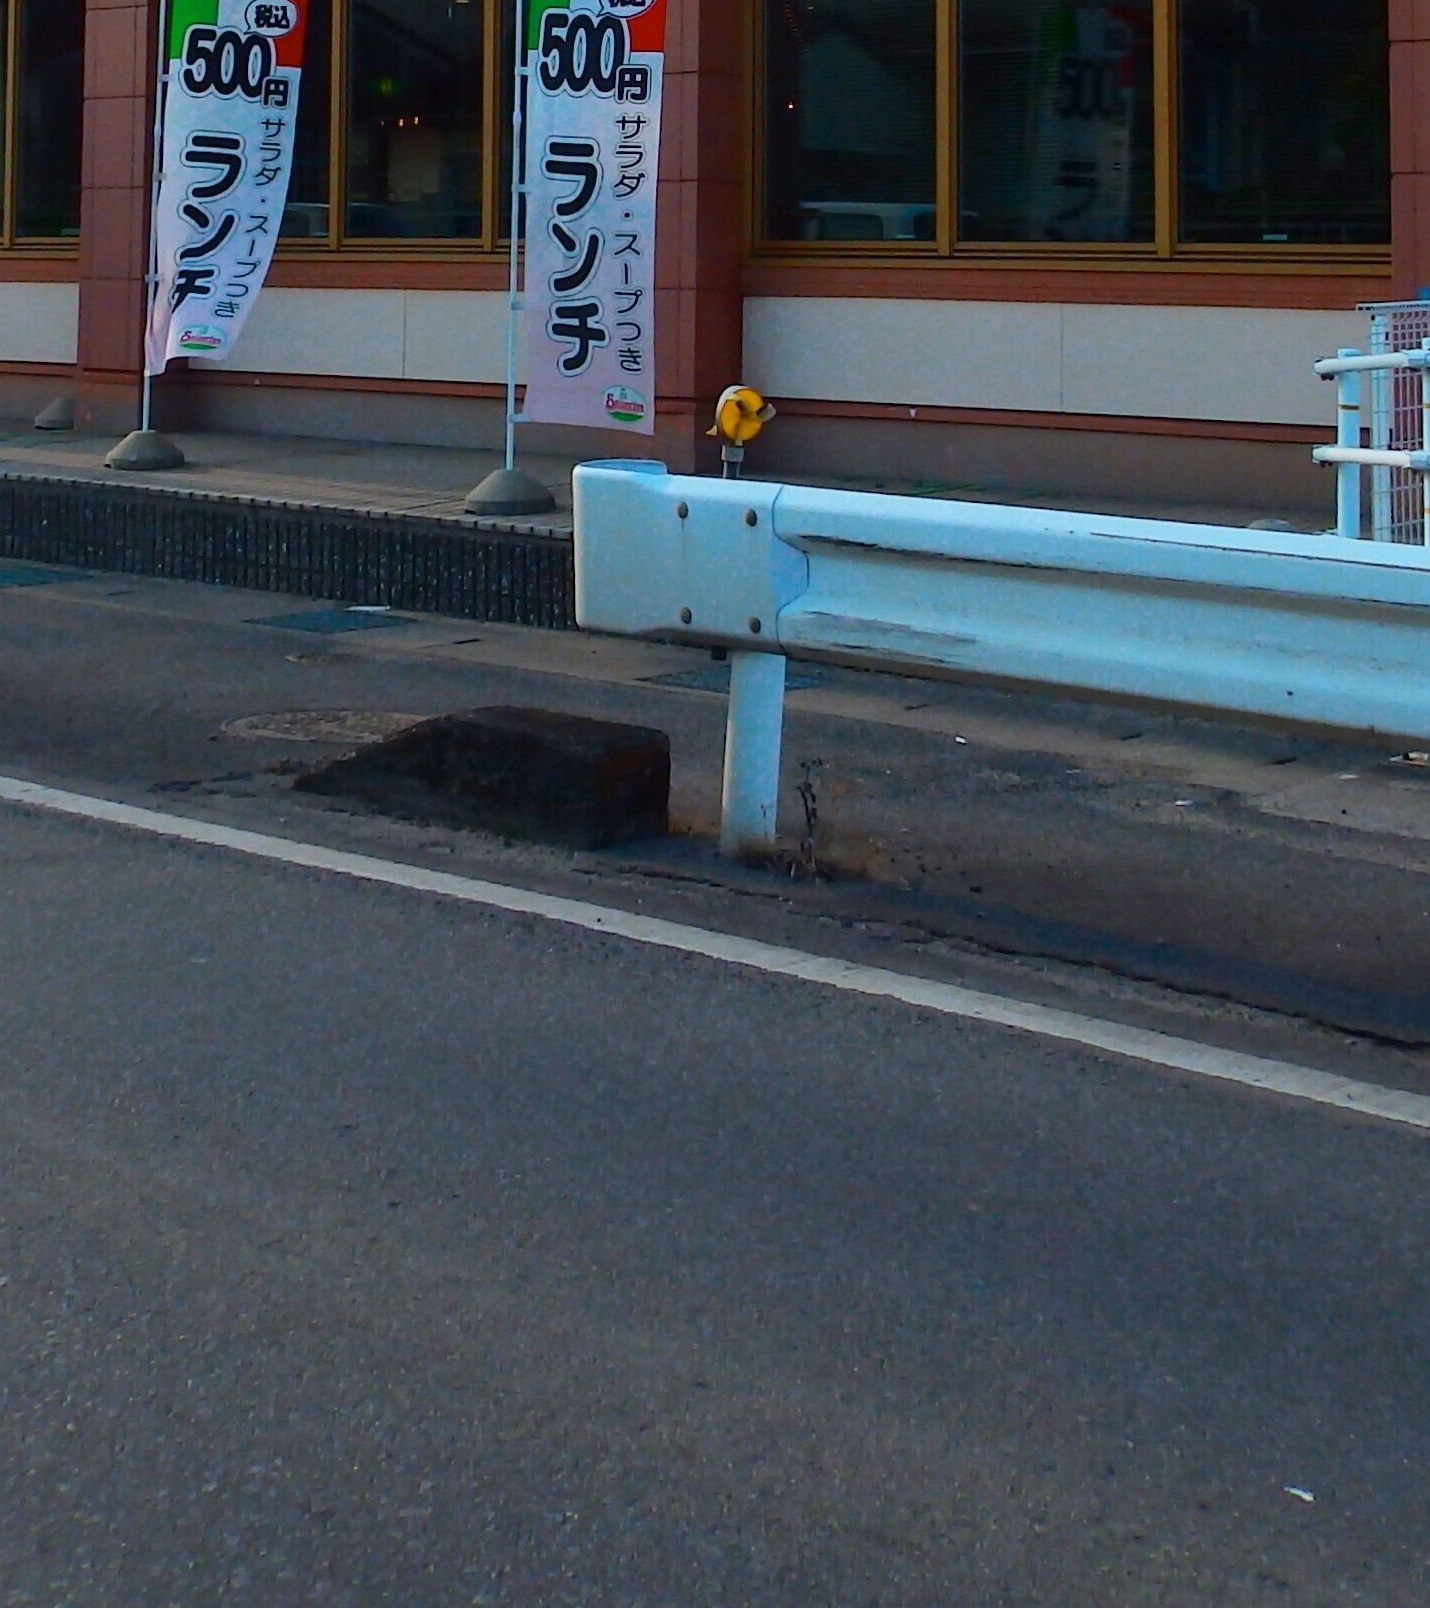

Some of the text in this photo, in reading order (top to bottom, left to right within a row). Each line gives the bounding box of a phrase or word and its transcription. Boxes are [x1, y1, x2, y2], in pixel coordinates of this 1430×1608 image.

[254, 5, 291, 29] 税込
[545, 141, 608, 371] ランチ
[614, 114, 648, 374] サラダ・スープつき
